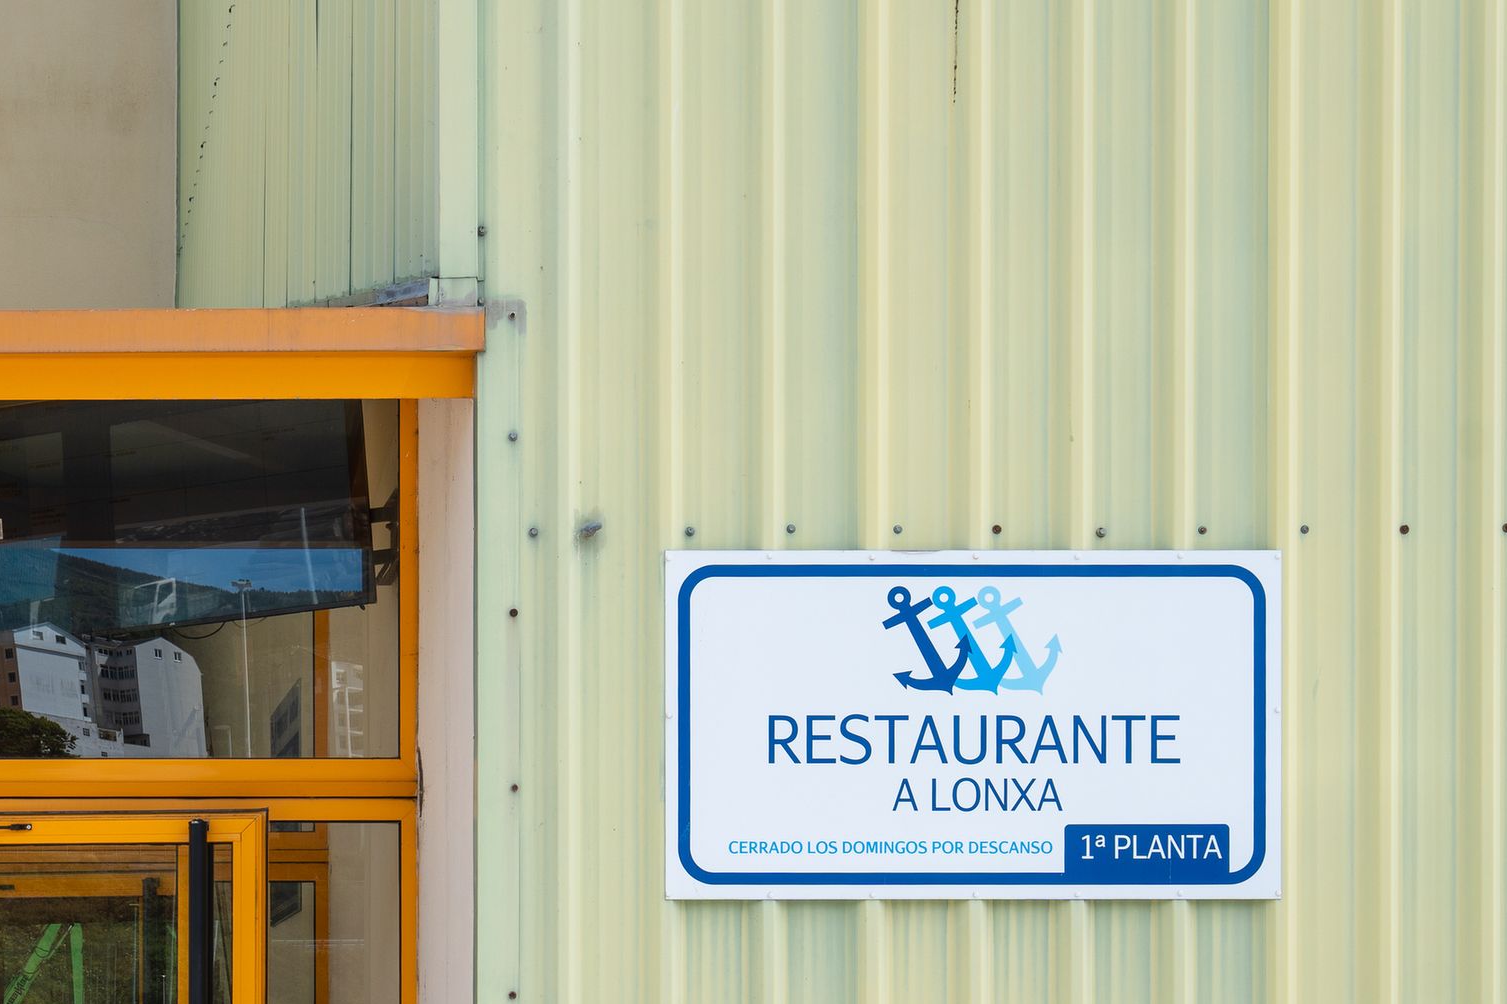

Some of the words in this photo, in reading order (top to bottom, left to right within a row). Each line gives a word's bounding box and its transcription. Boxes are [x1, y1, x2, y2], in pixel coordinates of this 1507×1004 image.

[768, 714, 1180, 765] RESTAURANTE
[893, 778, 918, 812] A
[932, 778, 1062, 812] LONXA
[729, 840, 803, 855] CERRADO
[808, 840, 837, 855] LOS
[843, 840, 927, 855] DOMINGOS
[932, 840, 963, 855] POR
[969, 840, 1052, 855] DESCANSO
[1082, 835, 1105, 860] 1ª
[1115, 835, 1223, 860] PLANTA
